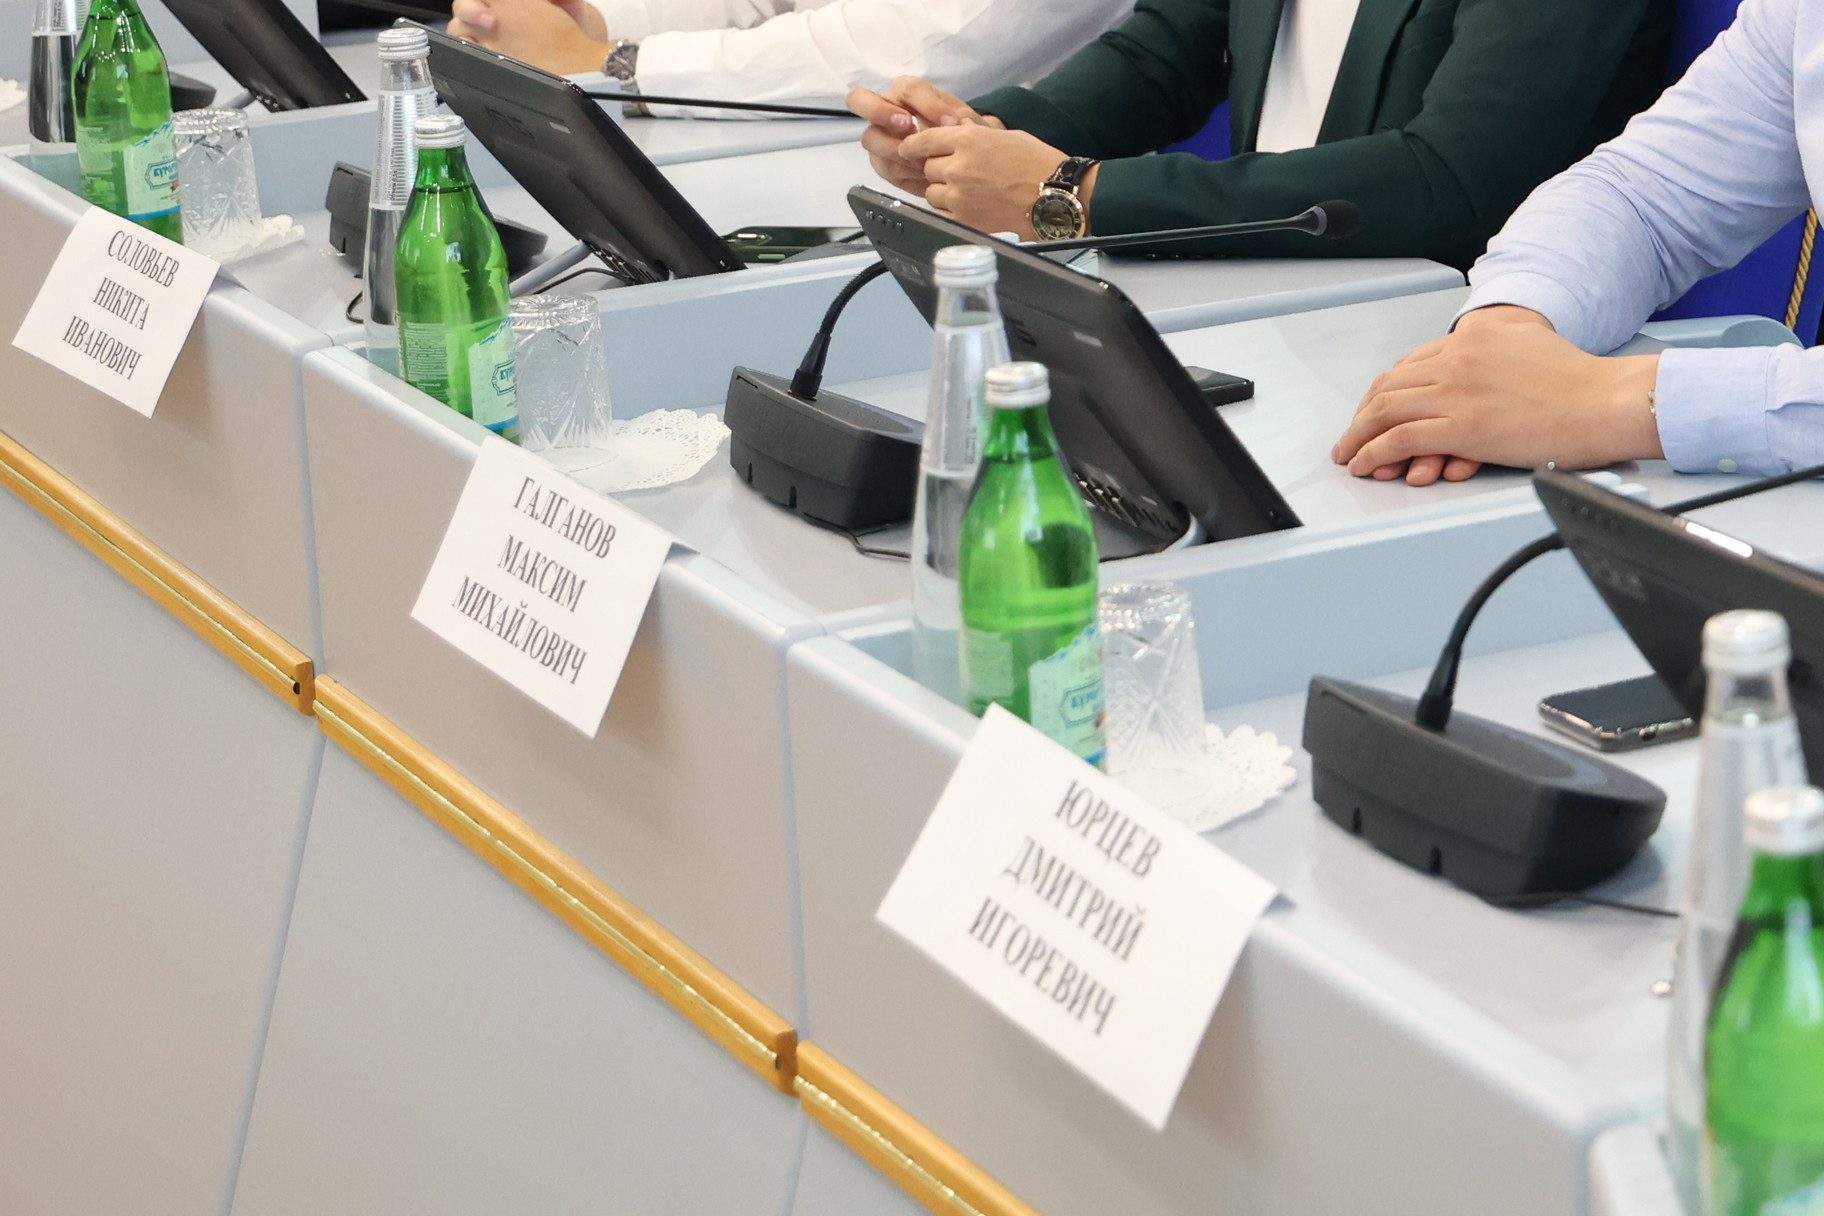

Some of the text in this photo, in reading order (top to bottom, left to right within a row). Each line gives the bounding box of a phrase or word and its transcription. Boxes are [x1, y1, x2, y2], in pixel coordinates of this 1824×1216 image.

[107, 230, 180, 288] СОЛОВЬЕВ
[93, 277, 150, 331] НИКИТА
[62, 315, 142, 381] ИВАНОВИЧ
[513, 476, 617, 560] ГАЛГАНОВ
[497, 534, 587, 613] МАКСИМ
[452, 576, 588, 685] МИХАЙЛОВИЧ
[1055, 779, 1163, 879] ЮРЦЕВ
[1002, 835, 1147, 962] ДМИТРИЙ
[968, 896, 1117, 1036] ИГОРЕВИЧ
